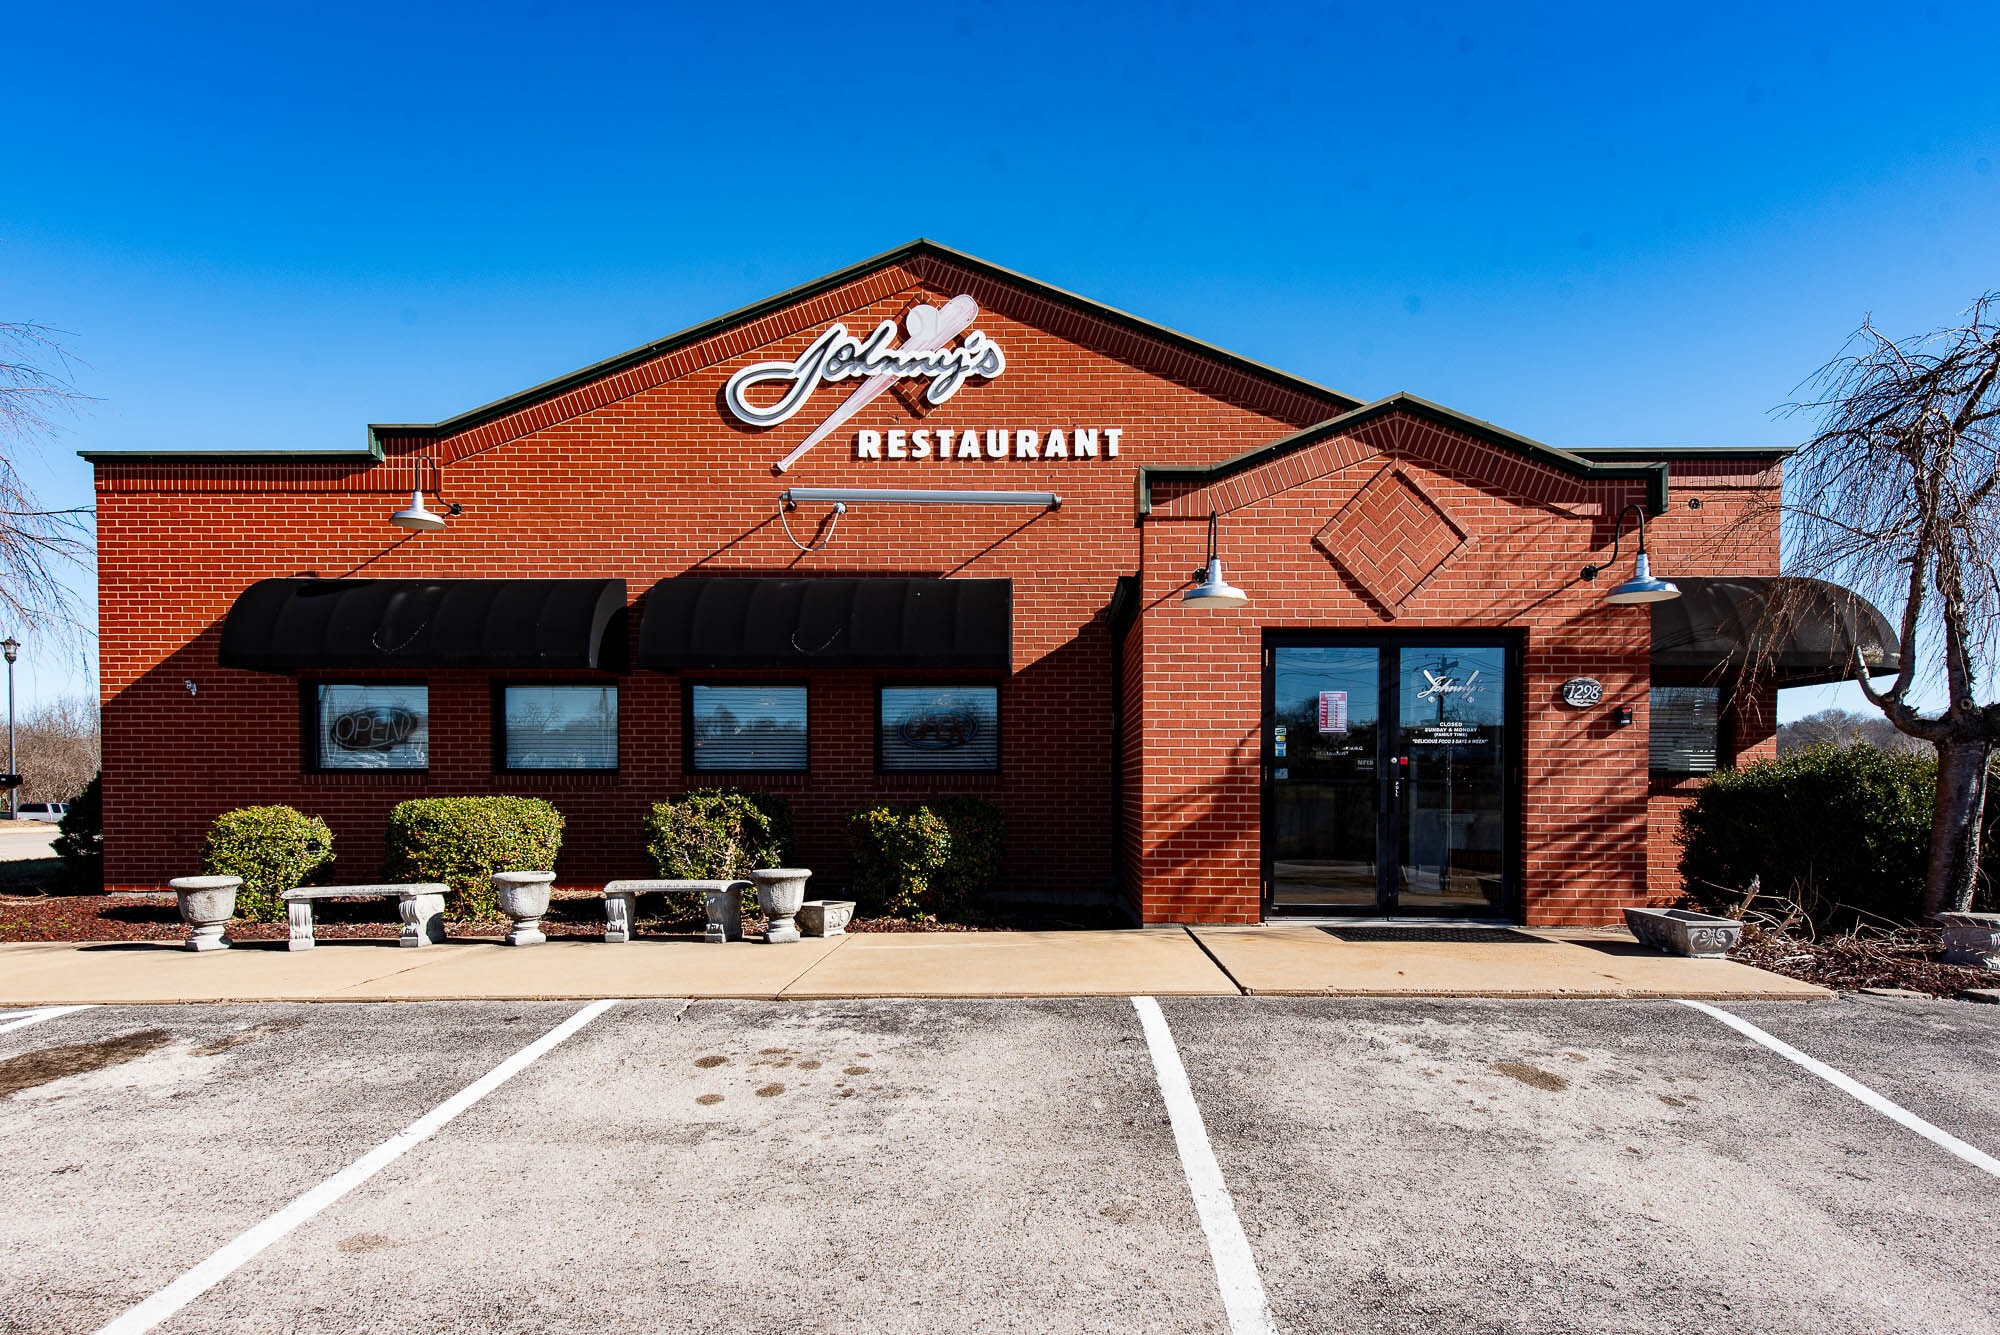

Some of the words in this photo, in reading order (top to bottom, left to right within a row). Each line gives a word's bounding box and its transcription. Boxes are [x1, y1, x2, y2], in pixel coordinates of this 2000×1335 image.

[726, 322, 1006, 426] Johnny's
[857, 428, 1122, 458] RESTAURANT
[1568, 685, 1601, 699] 1298
[336, 715, 405, 741] OPEN
